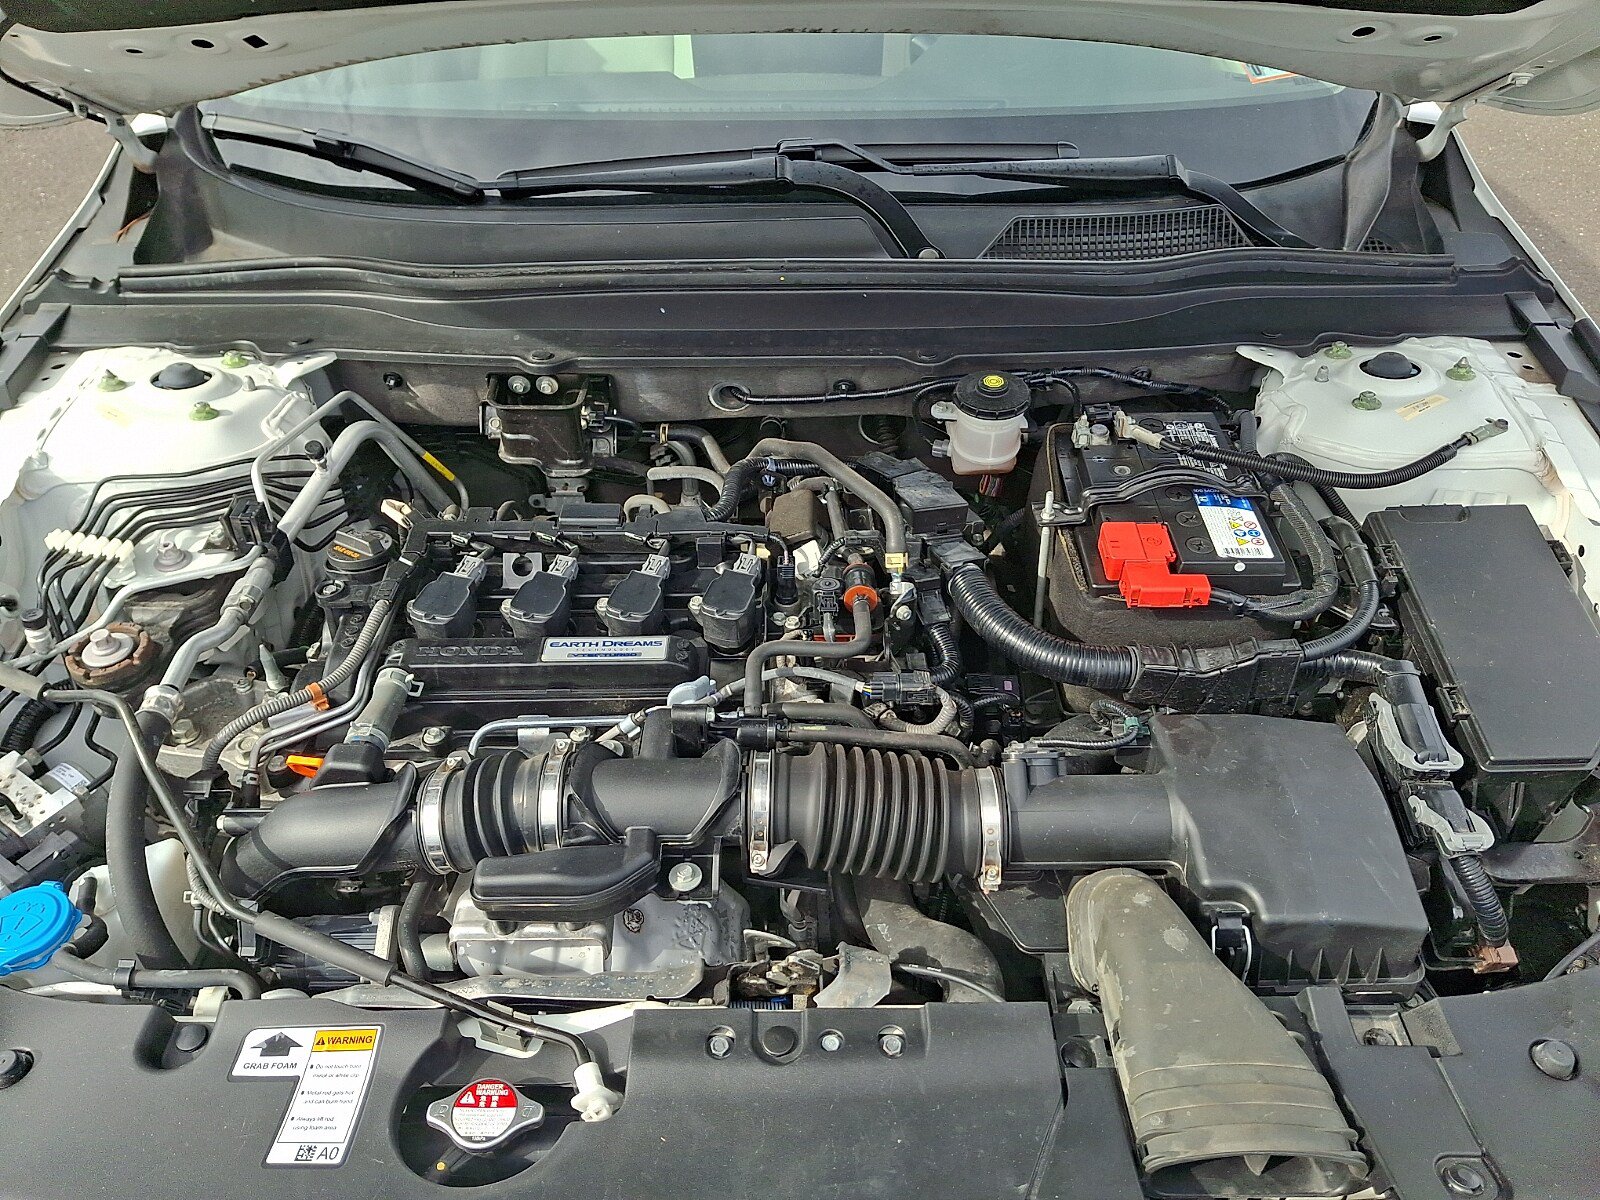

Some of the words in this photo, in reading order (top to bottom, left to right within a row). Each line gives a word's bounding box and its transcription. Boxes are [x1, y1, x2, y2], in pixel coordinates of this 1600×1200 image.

[416, 645, 524, 657] HONDA
[327, 1035, 373, 1045] WARNING
[243, 1062, 269, 1070] GRAB
[270, 1062, 298, 1070] FOAM
